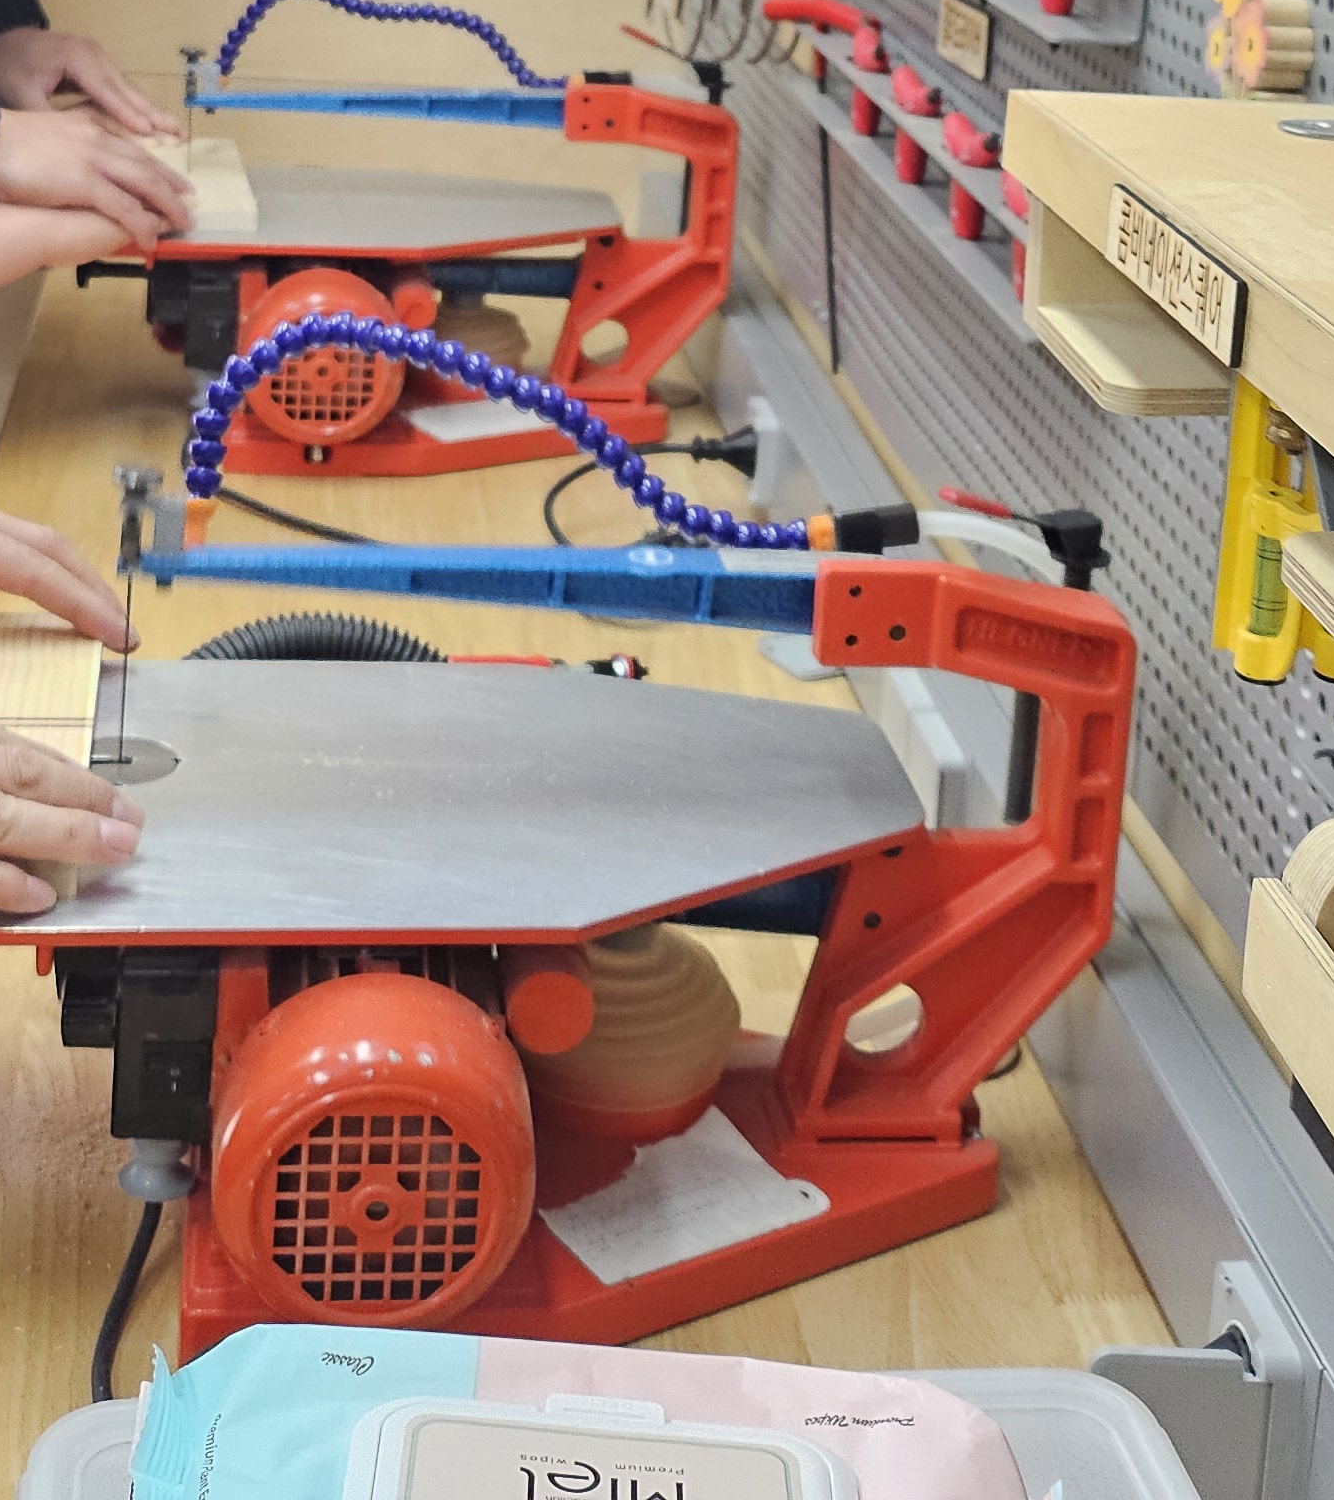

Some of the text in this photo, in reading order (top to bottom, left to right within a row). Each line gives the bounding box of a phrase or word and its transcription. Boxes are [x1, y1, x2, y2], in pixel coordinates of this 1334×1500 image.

[1118, 199, 1224, 349] 콤비네이션스퀘어
[321, 1351, 374, 1376] Classic
[520, 1454, 684, 1476] Premium wipes
